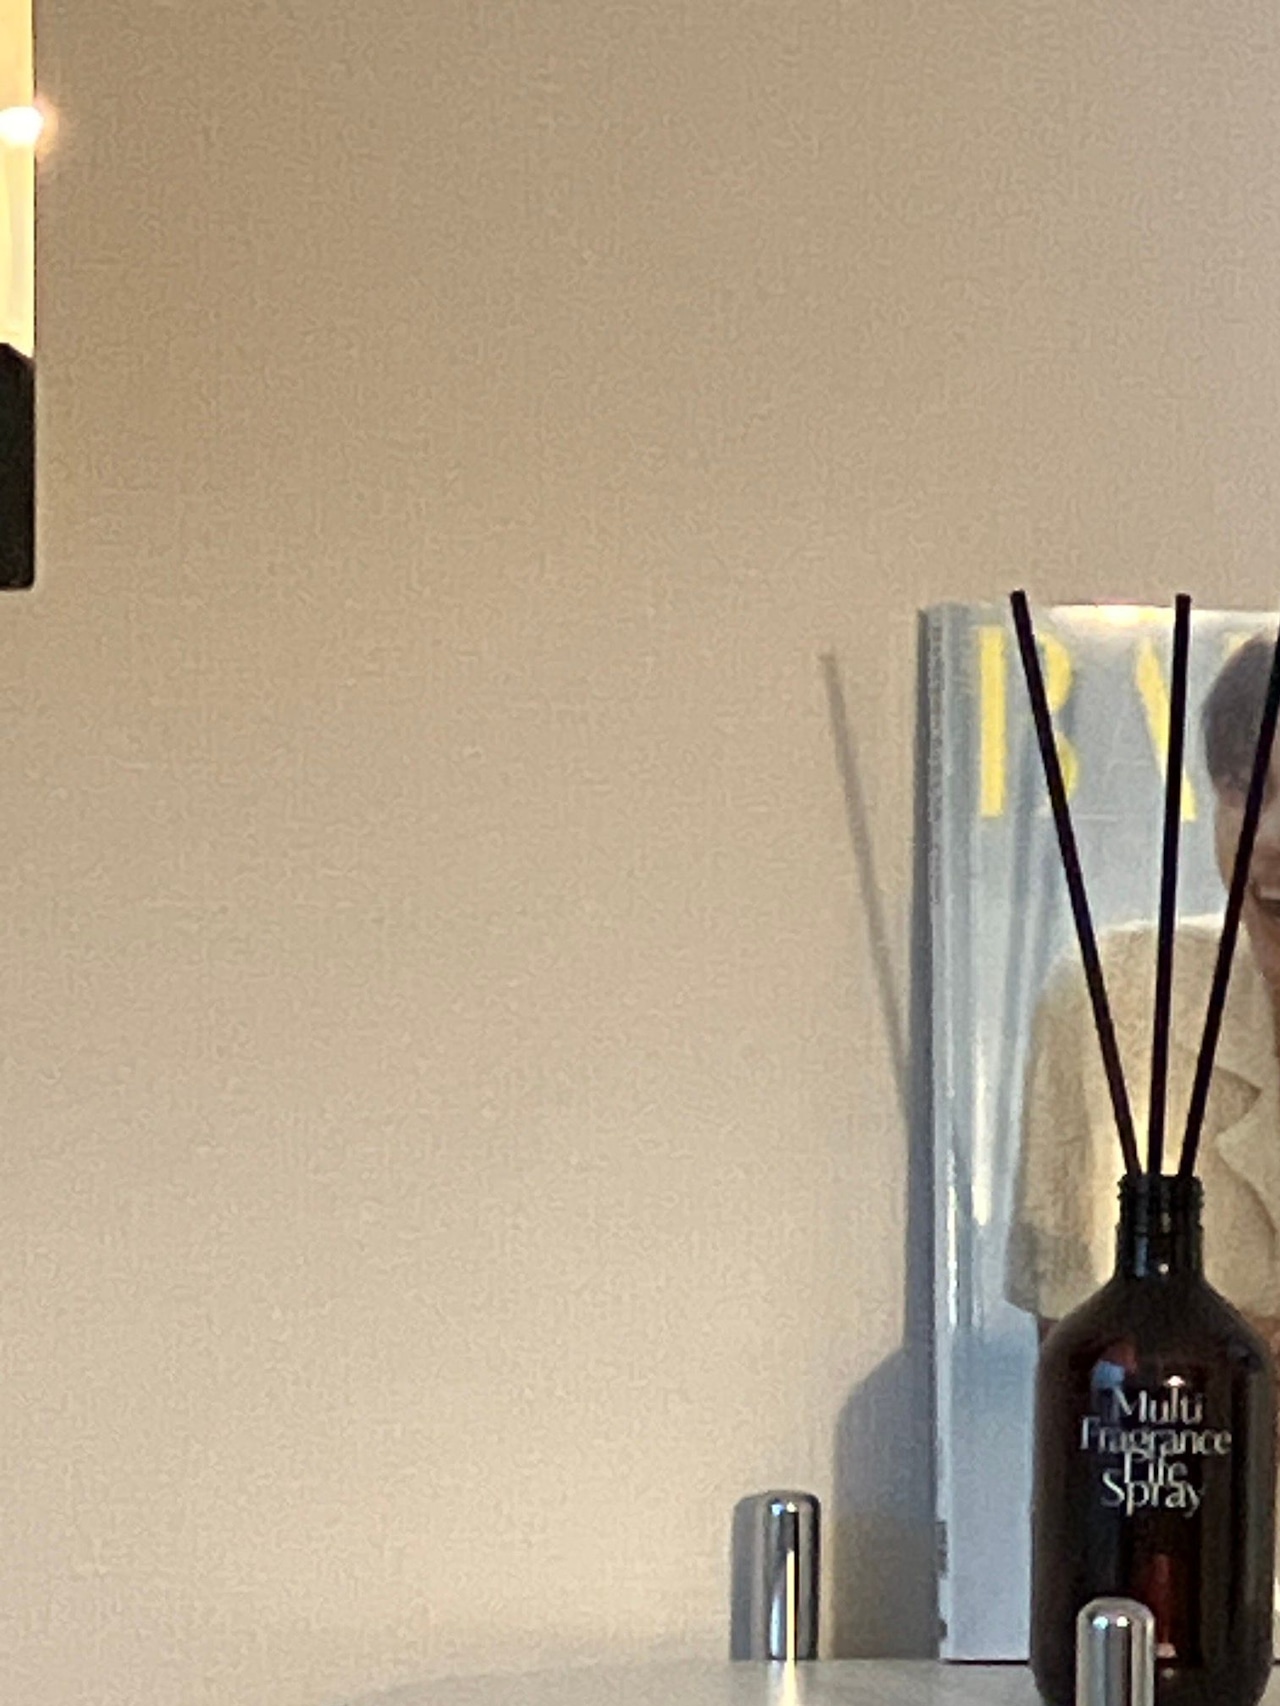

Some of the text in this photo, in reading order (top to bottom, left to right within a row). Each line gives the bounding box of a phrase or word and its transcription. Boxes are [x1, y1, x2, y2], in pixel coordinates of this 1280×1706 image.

[1107, 1382, 1204, 1425] Multi
[1079, 1415, 1233, 1462] Fragrance
[1100, 1467, 1205, 1519] Spray
